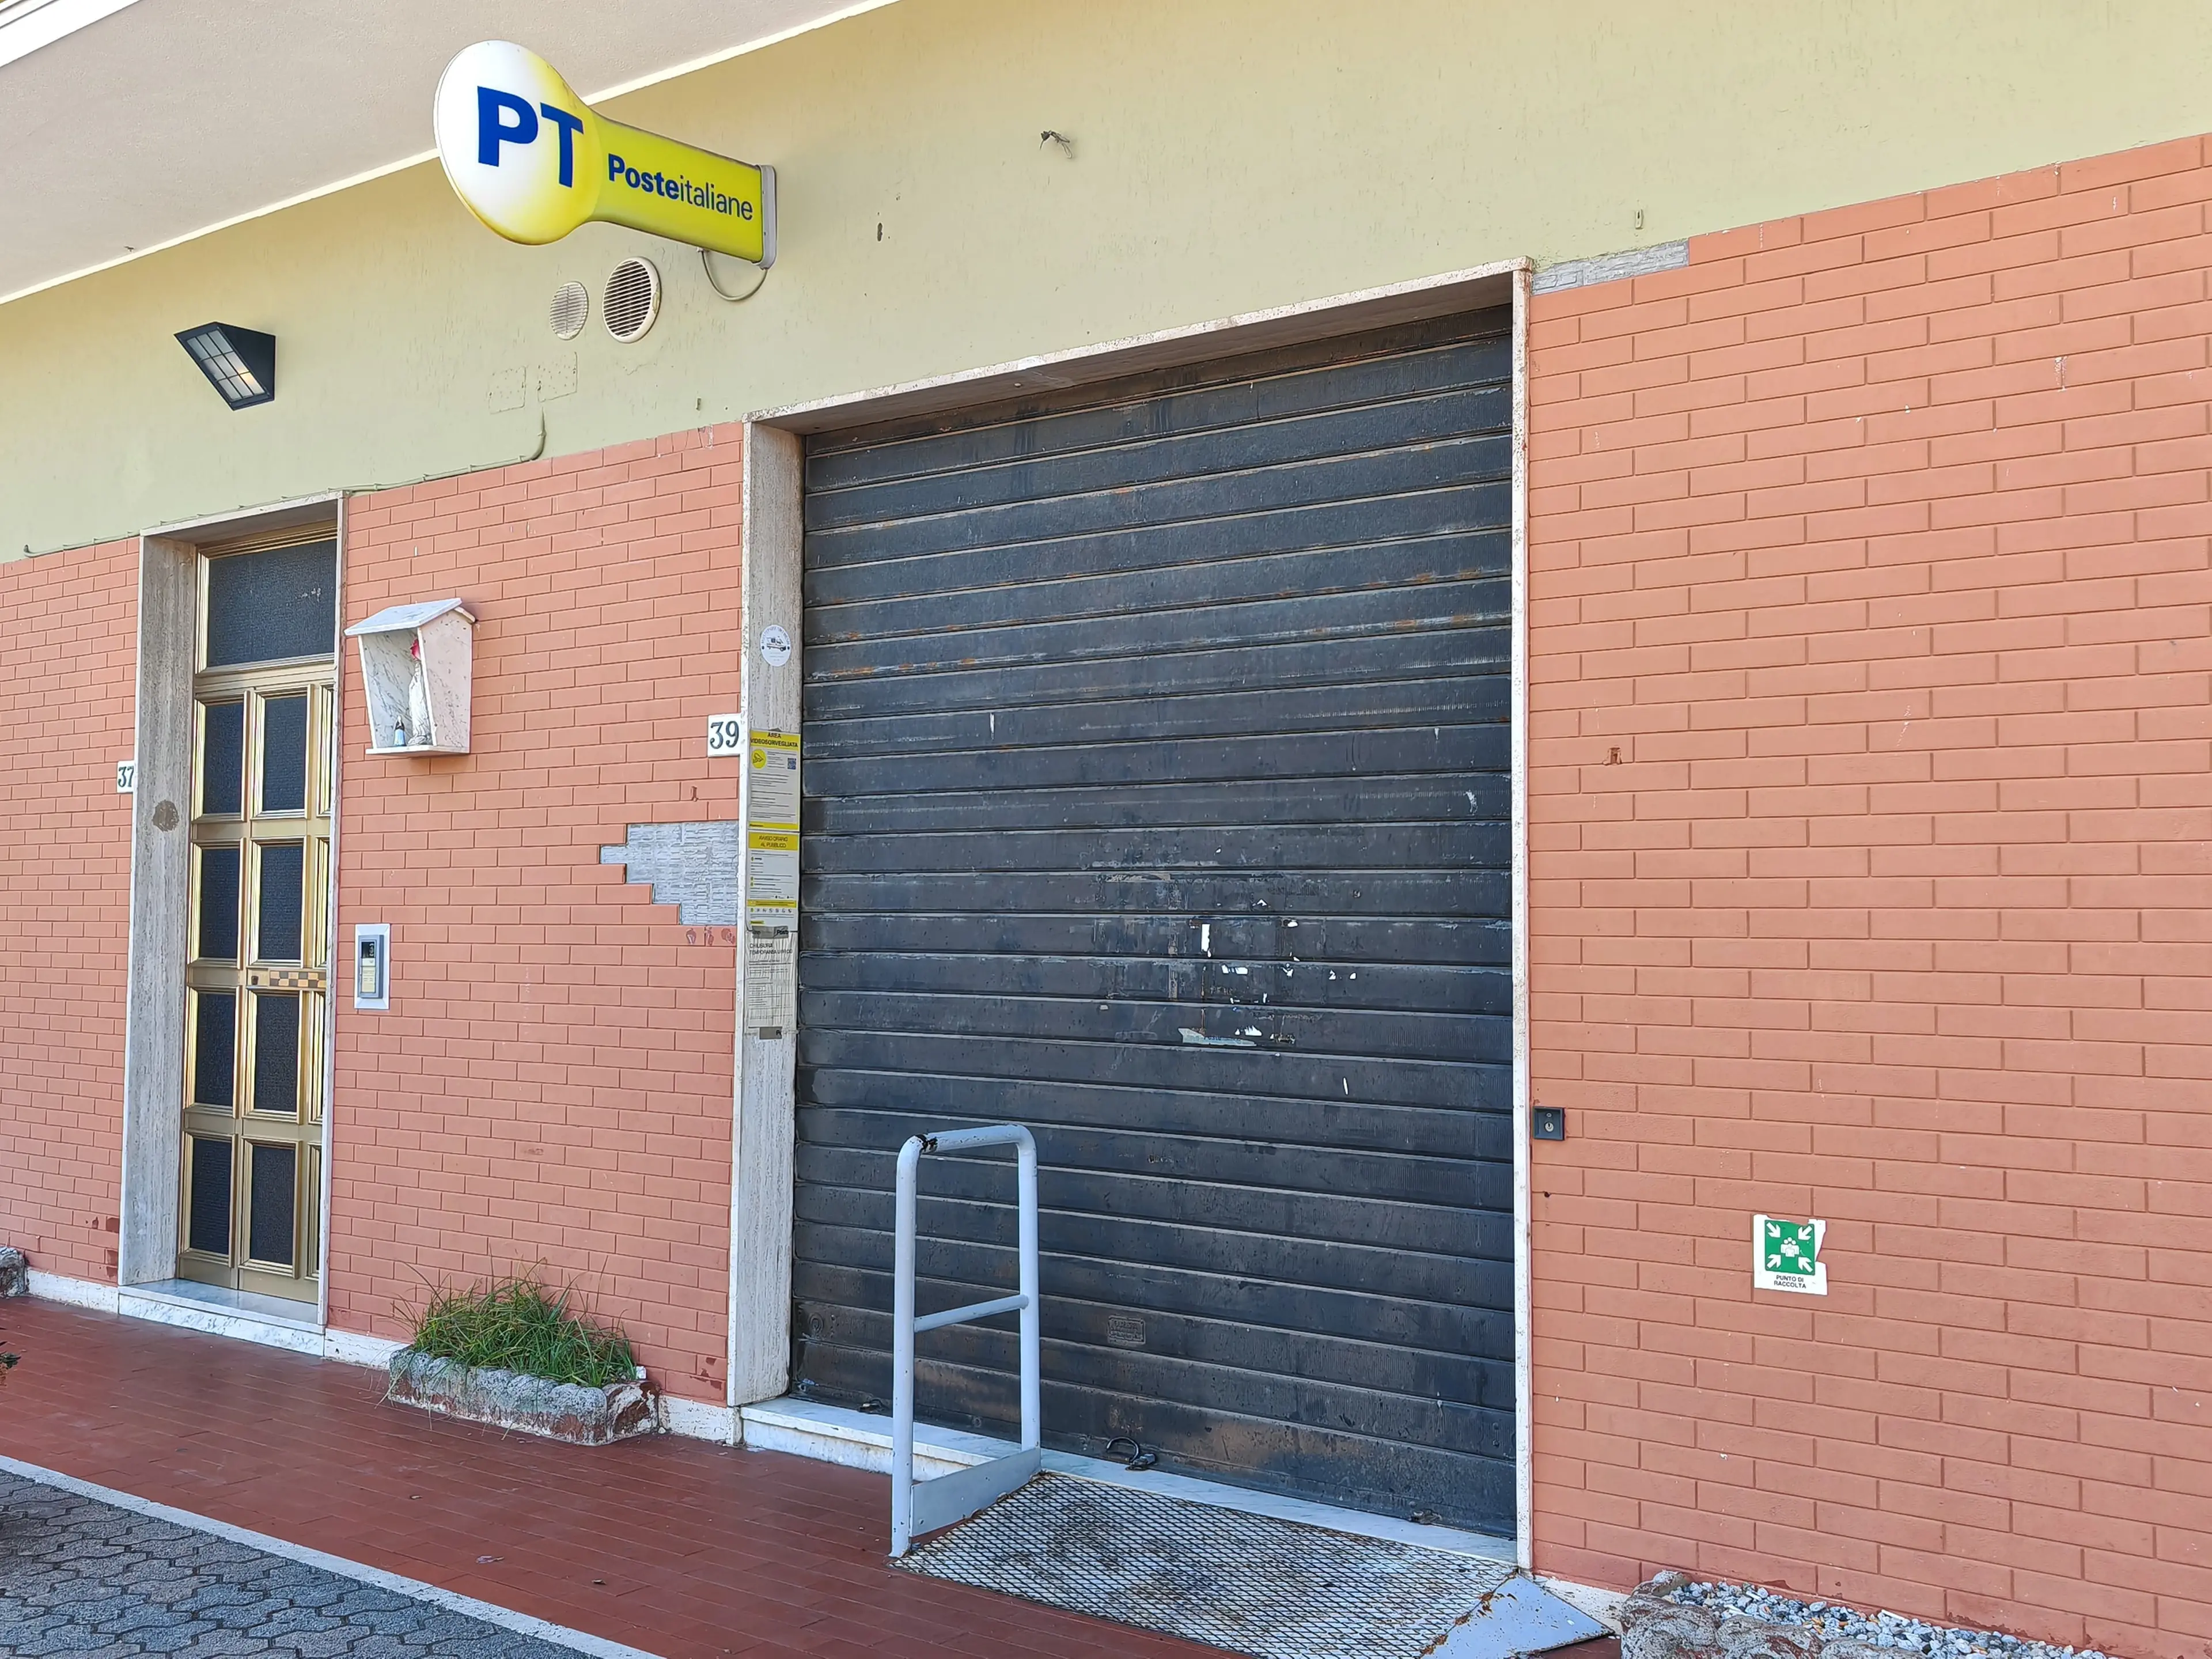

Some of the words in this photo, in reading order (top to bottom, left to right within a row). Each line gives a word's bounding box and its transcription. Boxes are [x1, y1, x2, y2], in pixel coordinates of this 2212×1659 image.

[477, 85, 584, 189] PT
[710, 720, 740, 749] 39
[750, 737, 798, 748] VIDEOSORVEGLIATA
[118, 765, 134, 787] 37
[1774, 1280, 1806, 1289] RACCOLTA
